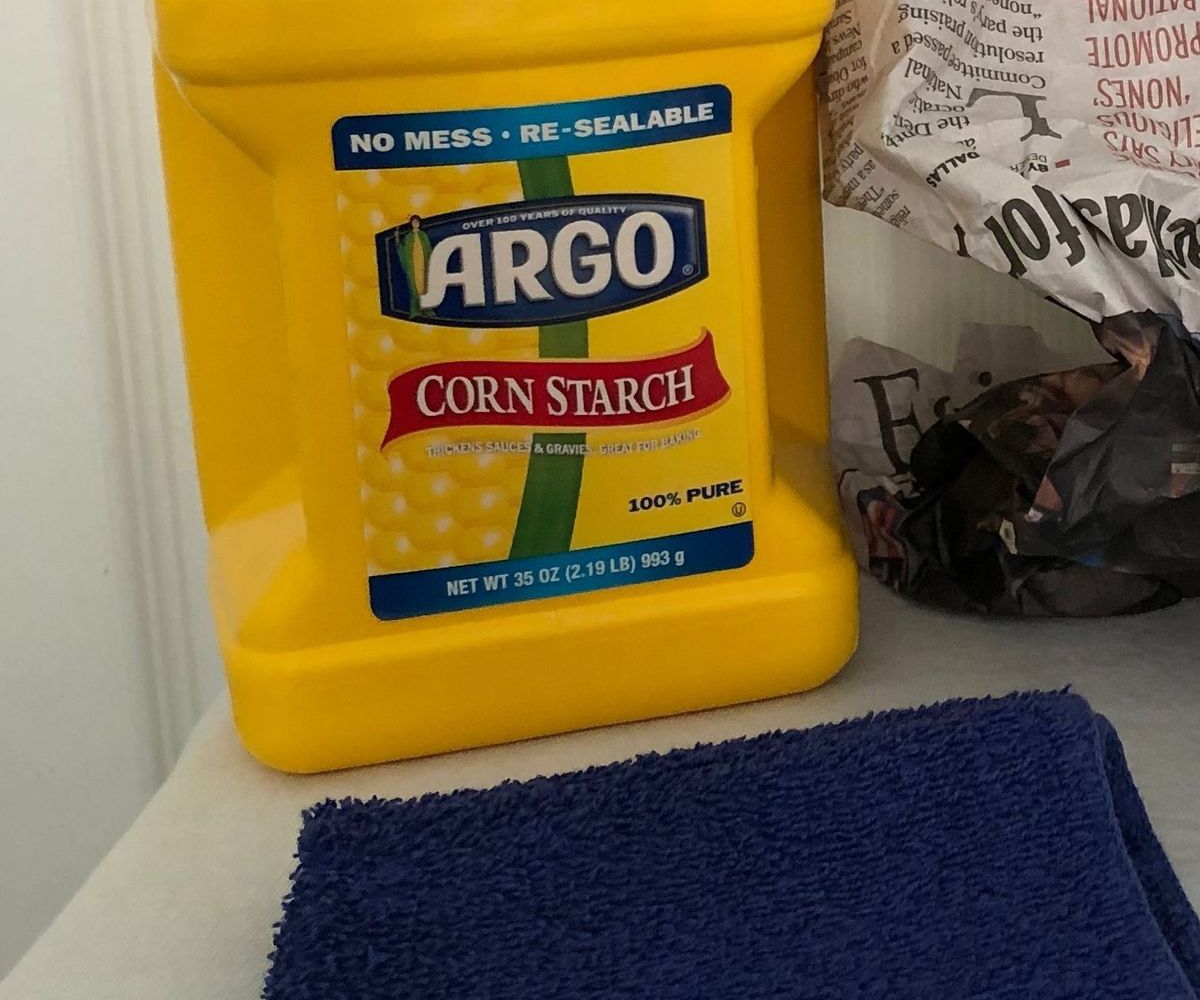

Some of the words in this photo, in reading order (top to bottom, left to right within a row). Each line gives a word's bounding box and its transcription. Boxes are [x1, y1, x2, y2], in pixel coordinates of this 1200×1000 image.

[897, 3, 964, 37] praising
[1012, 26, 1042, 41] the
[891, 40, 900, 54] a
[903, 31, 950, 65] passed
[350, 133, 394, 153] NO
[404, 127, 493, 151] MESS
[520, 102, 714, 143] RE-SEALABLE
[1102, 130, 1159, 164] SAYS
[925, 151, 980, 189] DALLAS
[1028, 162, 1048, 172] BY
[462, 218, 494, 230] OVER
[520, 209, 560, 222] YEARS
[561, 208, 576, 219] OF
[578, 205, 626, 216] QUALITY
[983, 184, 1085, 279] for
[420, 211, 675, 309] ARGO
[416, 374, 534, 416] CORN
[546, 364, 696, 416] STARCH
[487, 442, 532, 454] SAUCES
[535, 442, 544, 454] &
[600, 442, 632, 455] GREAT
[636, 440, 658, 452] FOR
[628, 492, 682, 512] 100%
[686, 479, 744, 503] PURE
[447, 577, 478, 597] NET
[484, 574, 508, 592] WT
[514, 571, 534, 587] 35
[540, 567, 560, 583] OZ
[565, 560, 606, 583] (2.19
[610, 556, 636, 573] LB)
[641, 551, 671, 569] 993
[674, 550, 685, 566] g
